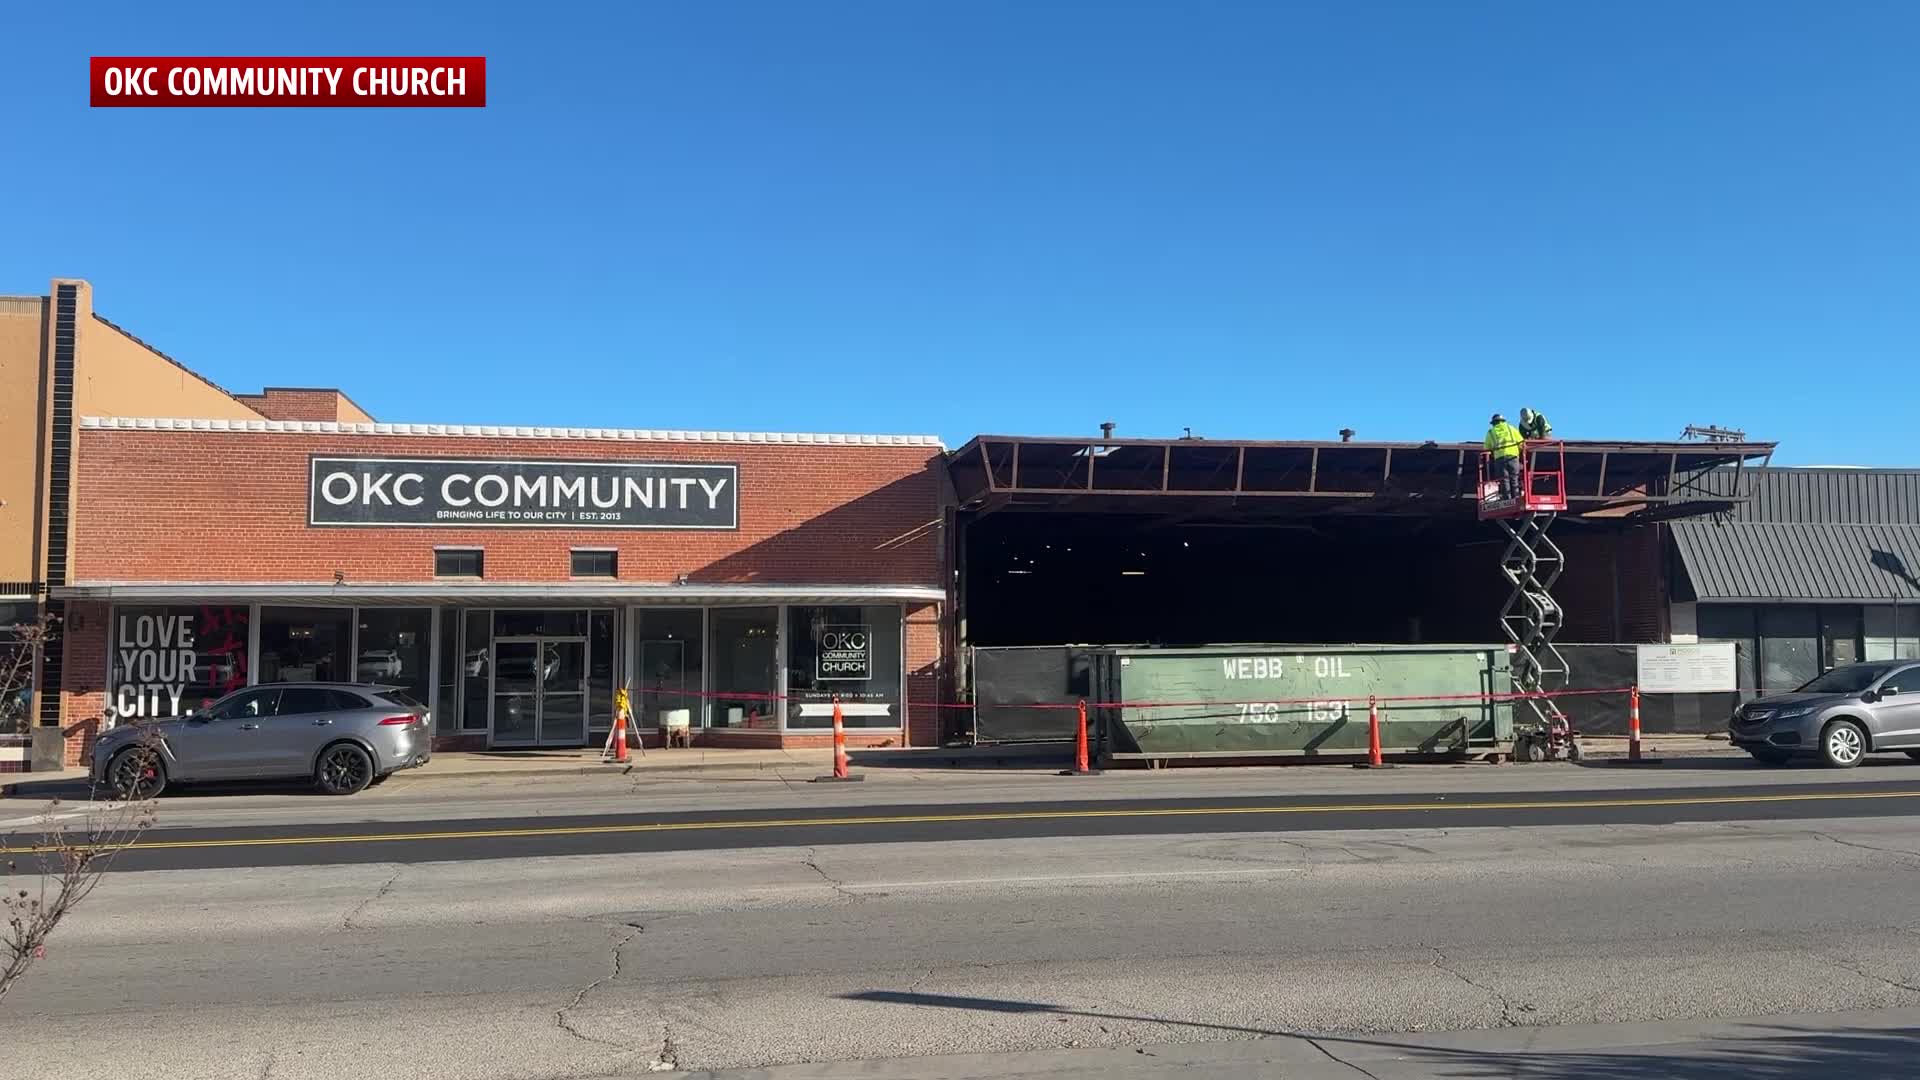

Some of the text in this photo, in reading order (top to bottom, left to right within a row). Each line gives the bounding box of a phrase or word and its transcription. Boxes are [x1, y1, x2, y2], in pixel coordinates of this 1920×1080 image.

[321, 472, 728, 510] OKC COMMUNITY
[436, 510, 567, 521] BRINGING LIFE TO OUR CITY
[579, 511, 621, 521] EST. 2013
[120, 615, 195, 649] LOVE
[823, 632, 866, 650] OKC
[120, 648, 198, 683] YOUR
[822, 651, 866, 660] COMMUNITY
[822, 661, 866, 672] CHURCH
[1223, 656, 1352, 680] WEBB OIL
[118, 683, 194, 718] CITY.
